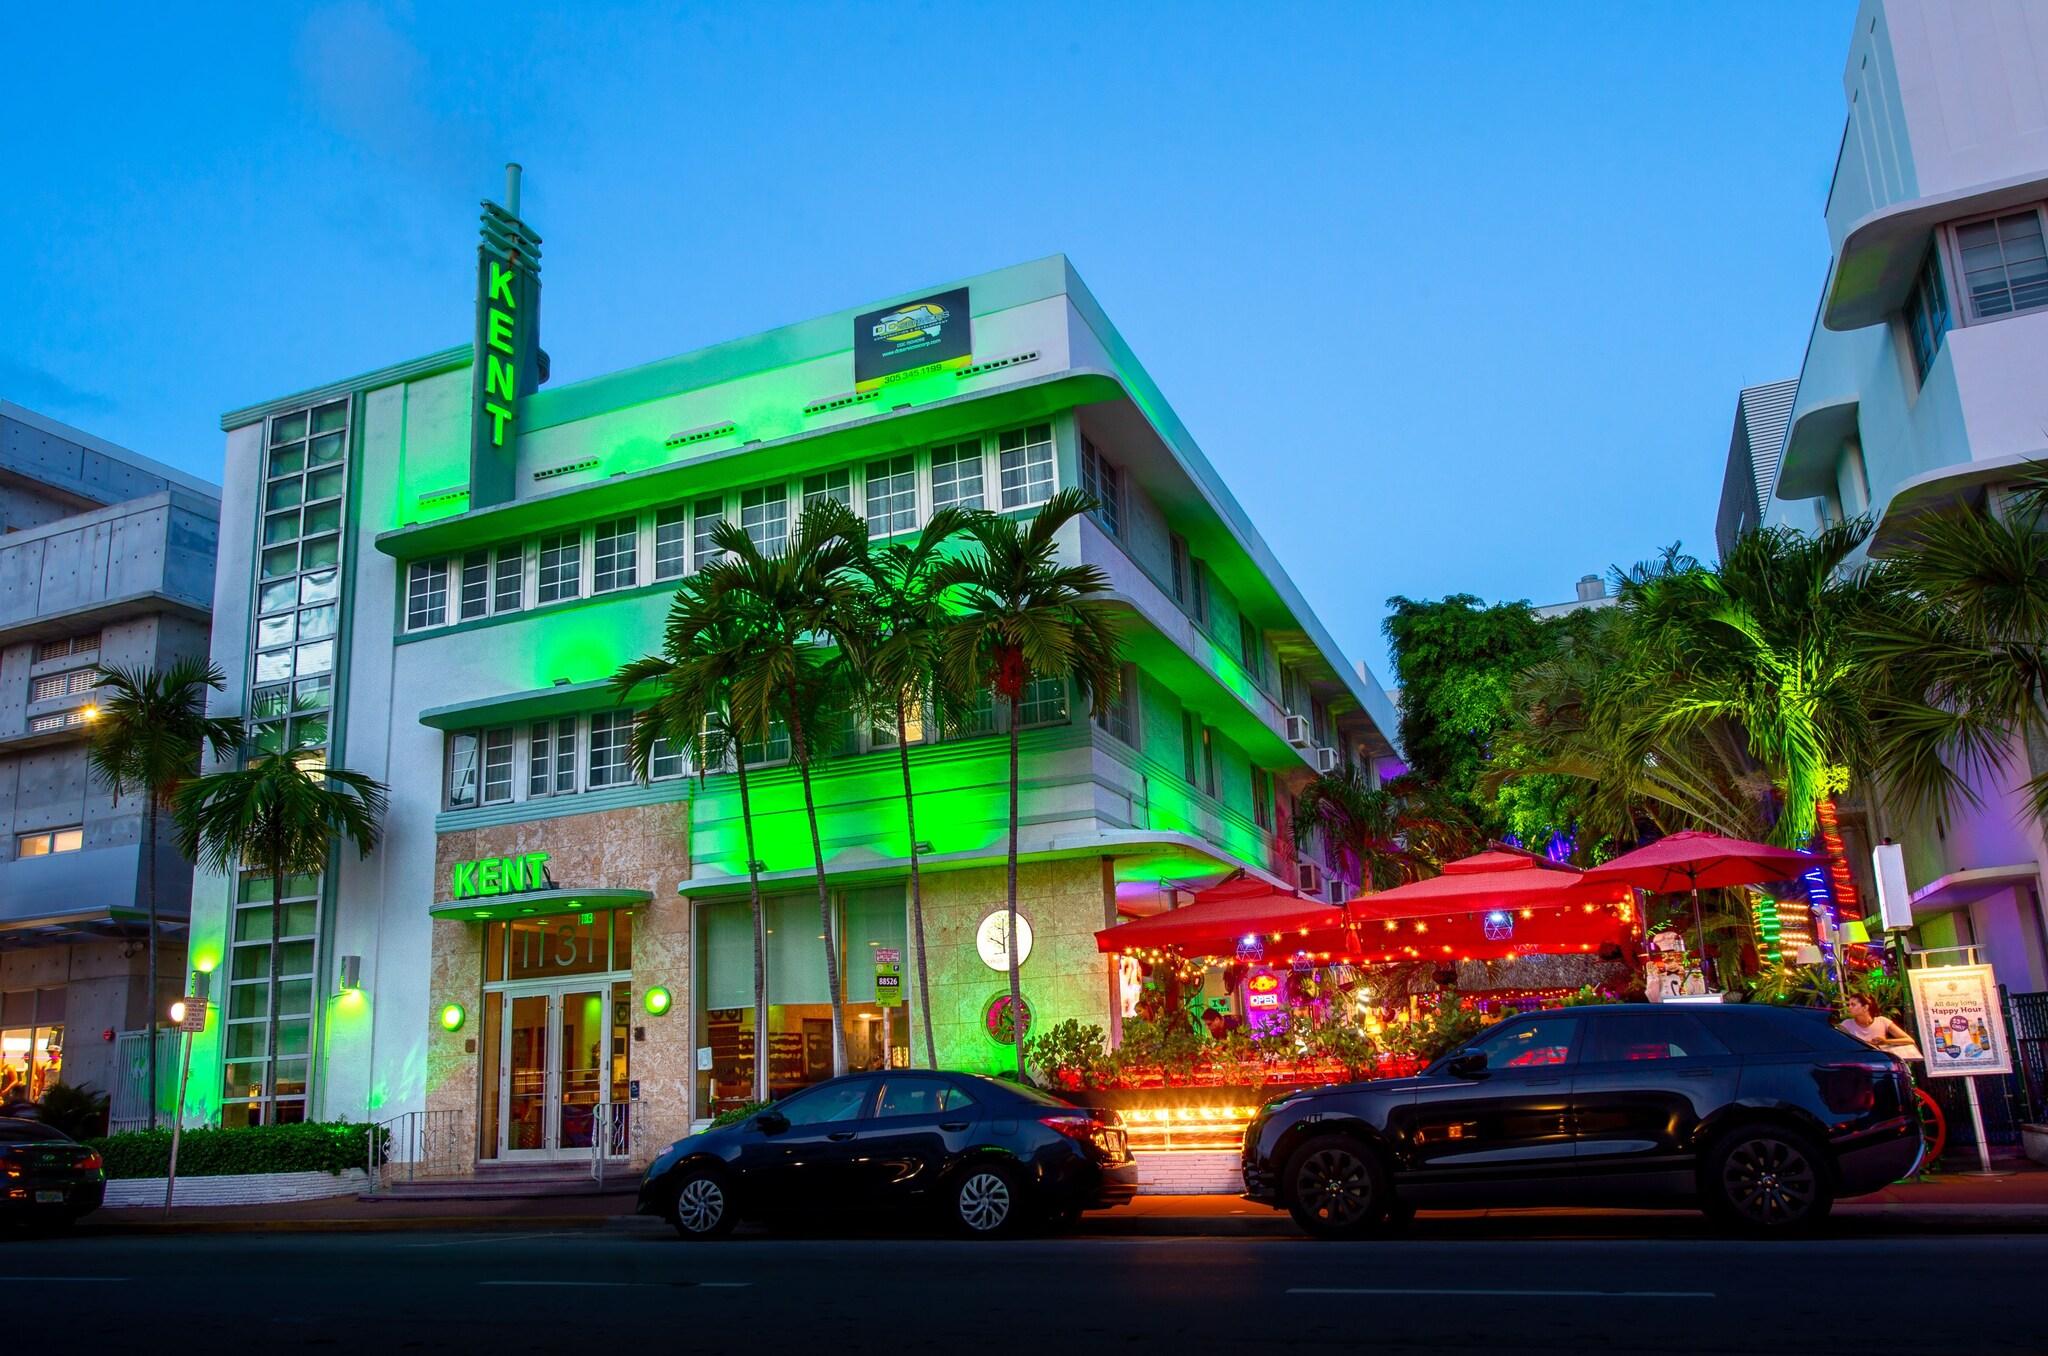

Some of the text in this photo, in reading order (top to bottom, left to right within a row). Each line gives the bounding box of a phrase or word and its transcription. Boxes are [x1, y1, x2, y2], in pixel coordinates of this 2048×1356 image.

[485, 260, 516, 448] KENT
[454, 852, 548, 897] KENT
[523, 925, 593, 968] 1131
[879, 977, 898, 985] 88526
[1250, 994, 1277, 1005] OPEN
